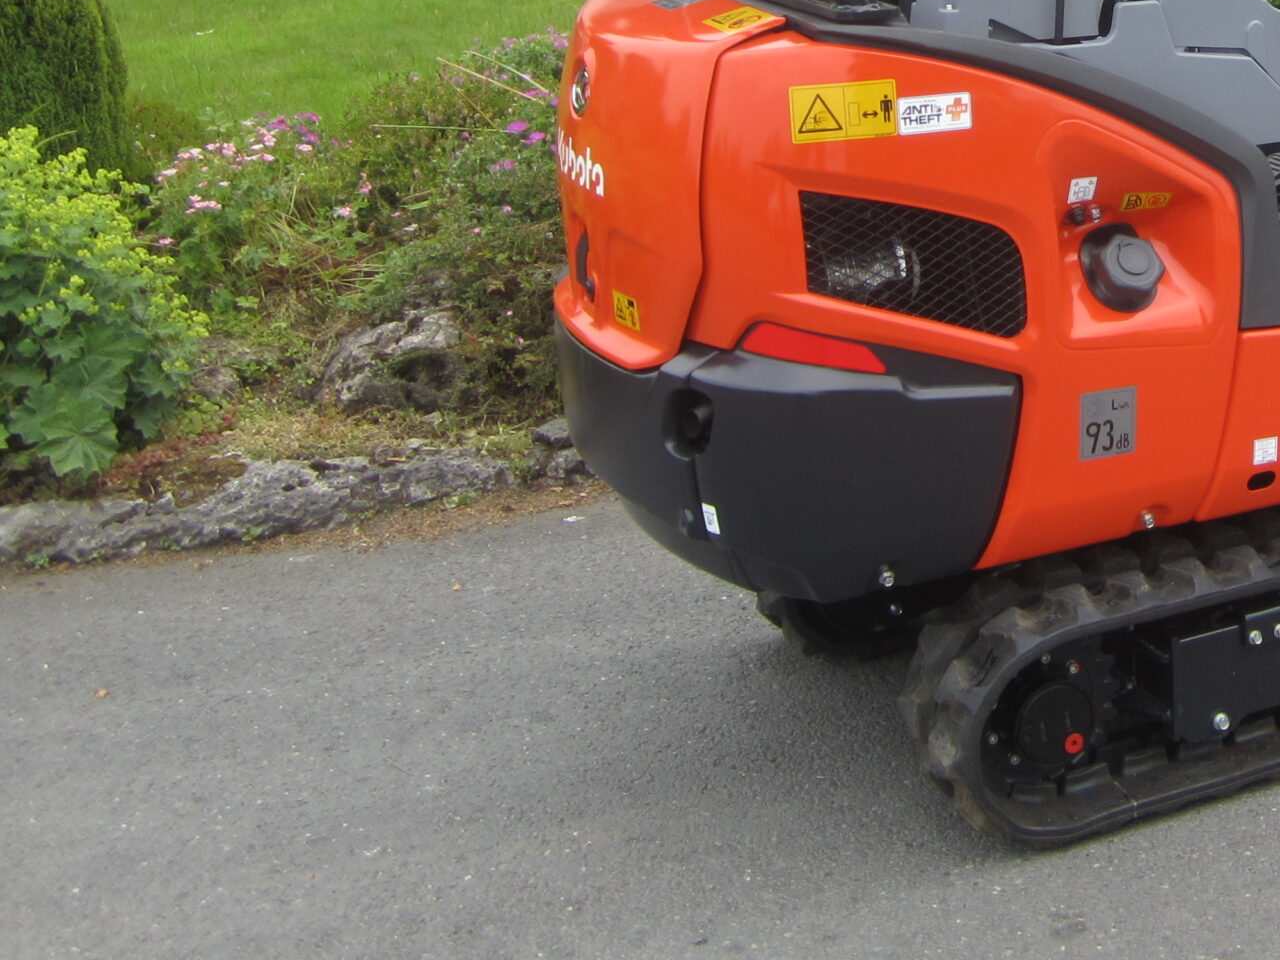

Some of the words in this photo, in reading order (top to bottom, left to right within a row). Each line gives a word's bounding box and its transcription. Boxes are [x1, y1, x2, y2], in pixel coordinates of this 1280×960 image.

[901, 104, 934, 116] ANTI
[901, 113, 943, 126] THEFT
[557, 126, 605, 197] Kubota
[1086, 419, 1114, 454] 93
